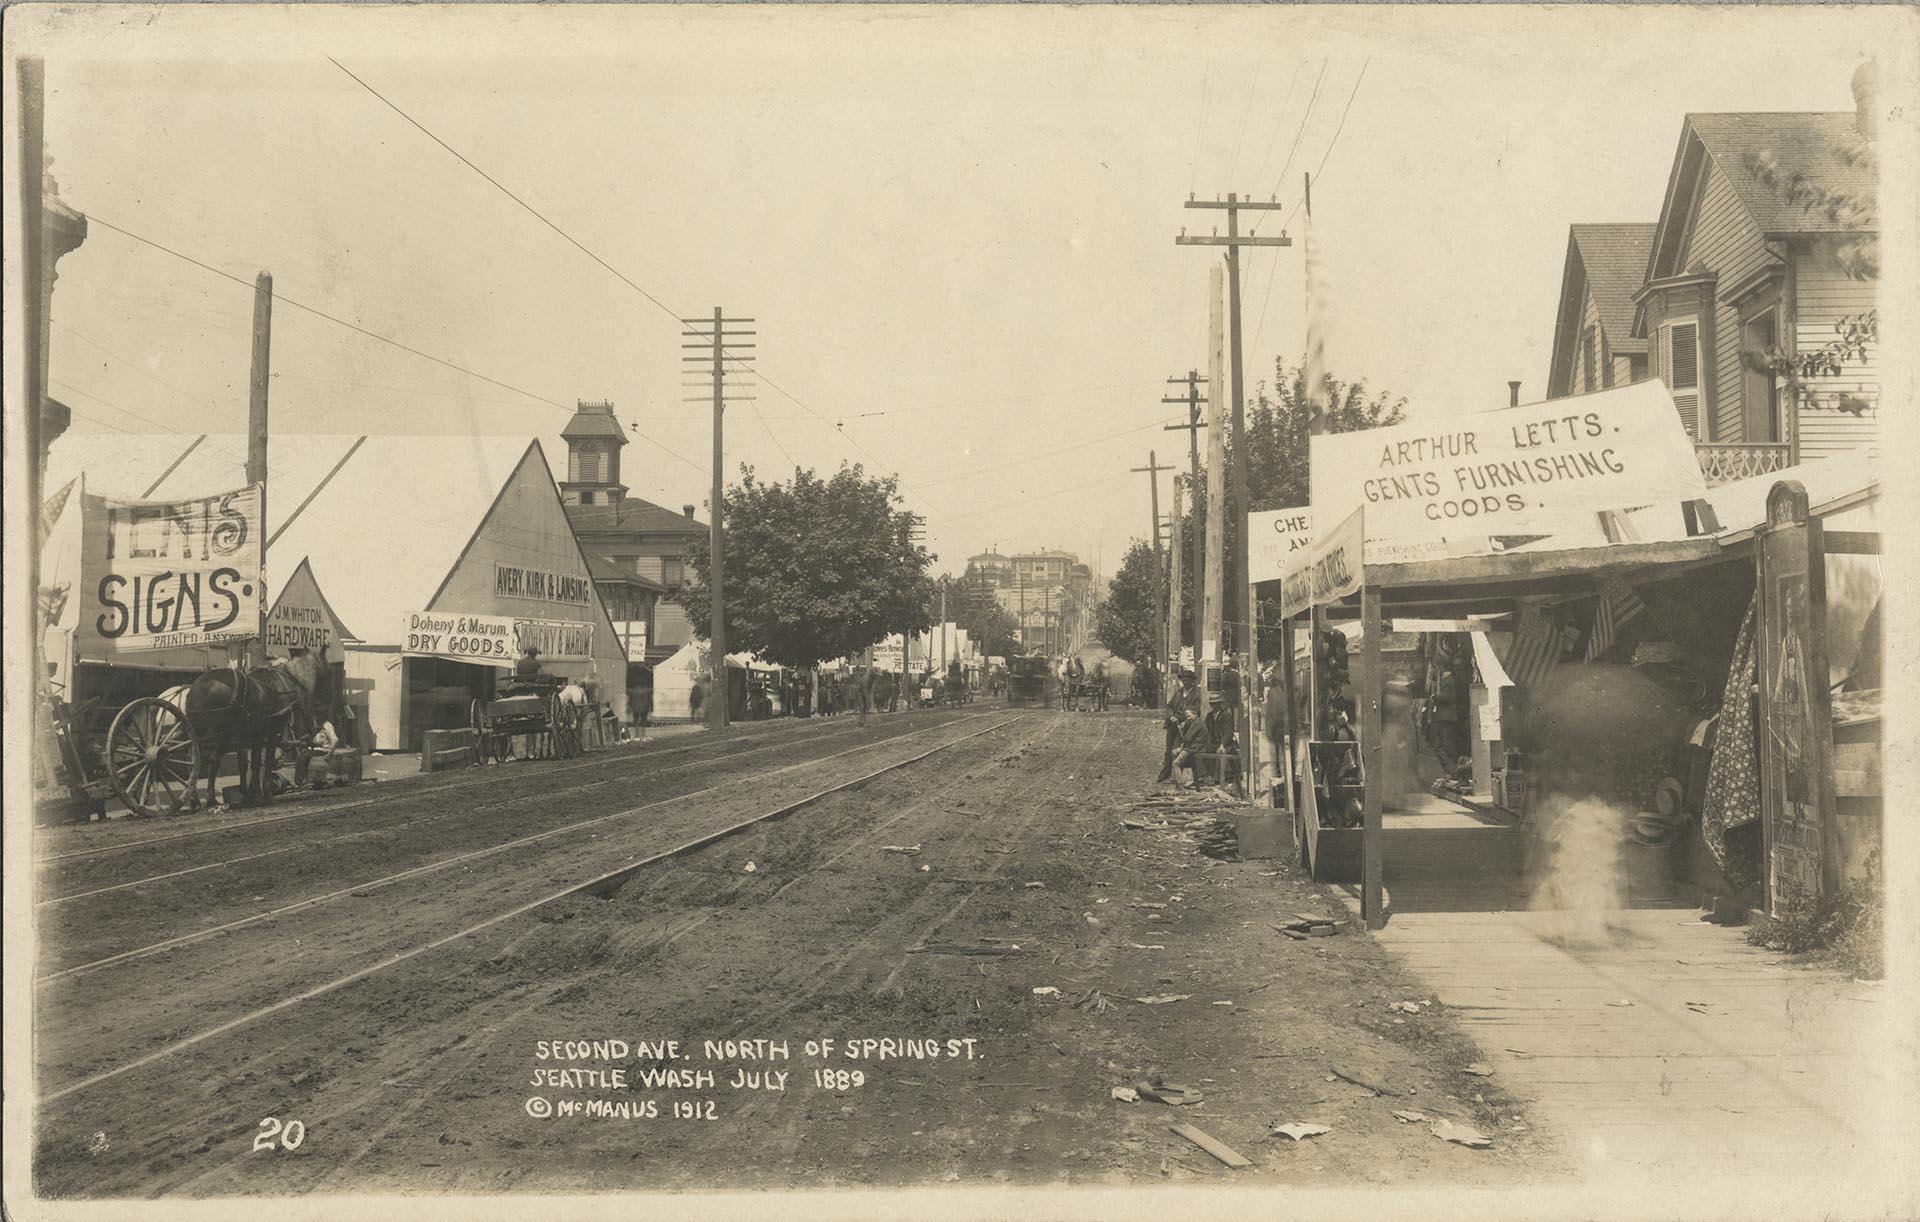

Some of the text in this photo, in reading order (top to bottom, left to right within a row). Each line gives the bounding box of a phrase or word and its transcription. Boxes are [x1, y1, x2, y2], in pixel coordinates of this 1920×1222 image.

[1379, 412, 1620, 468] ARTHUR LETTS.
[1363, 448, 1625, 503] GENTS FURNISHING
[1273, 516, 1313, 533] CHE
[526, 568, 546, 597] KIRK
[549, 574, 555, 597] &
[268, 624, 331, 649] HARDWARE
[411, 614, 454, 634] Doheny
[457, 617, 467, 633] &
[408, 634, 509, 655] DRY GOODS.
